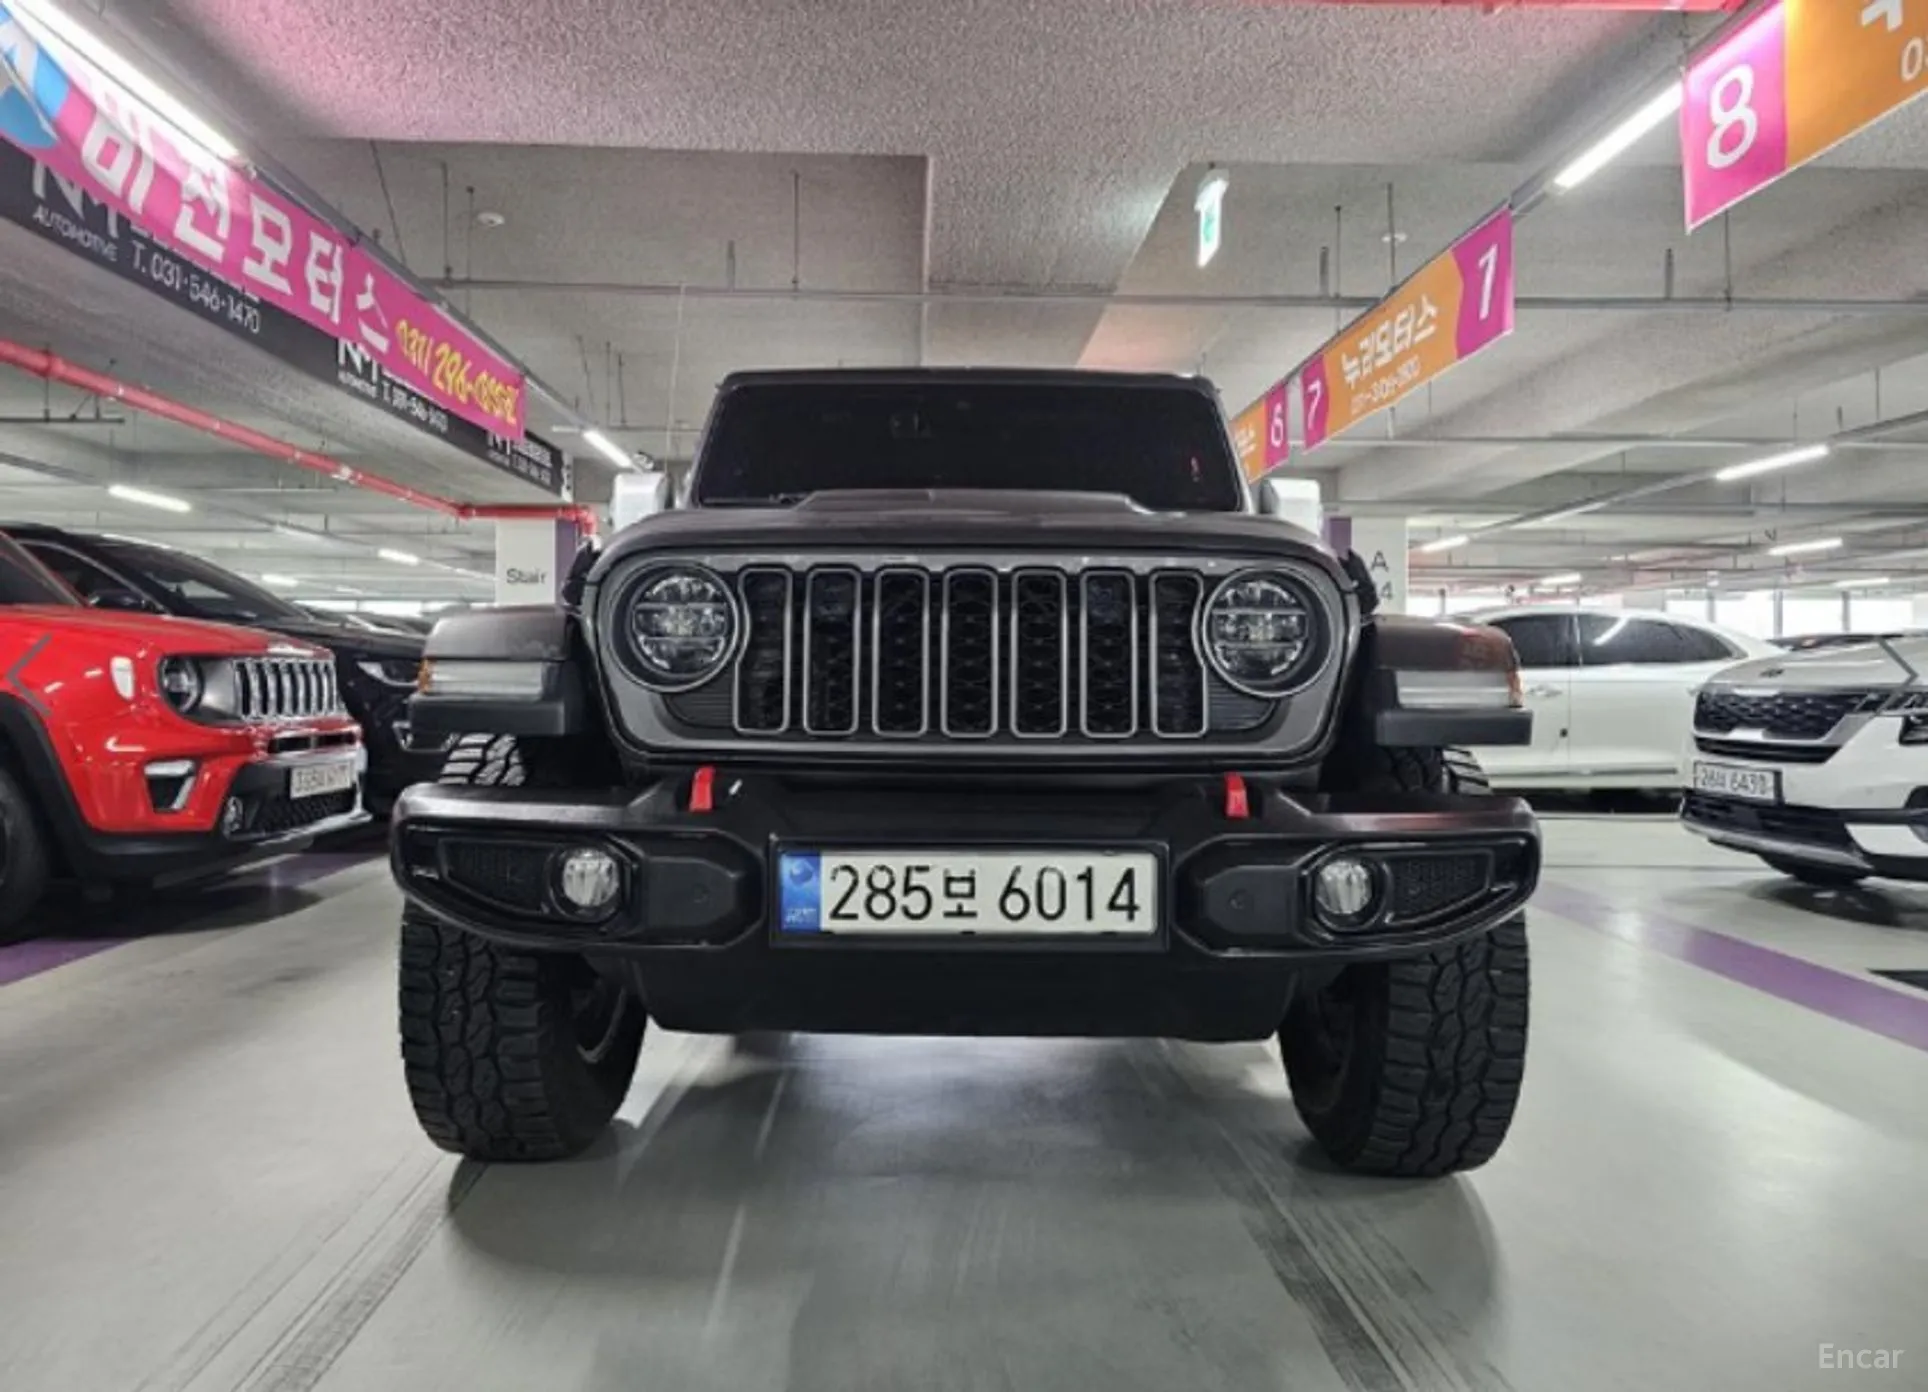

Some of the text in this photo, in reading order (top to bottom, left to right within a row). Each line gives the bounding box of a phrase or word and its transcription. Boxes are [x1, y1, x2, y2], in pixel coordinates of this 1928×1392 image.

[1706, 63, 1758, 170] 8
[32, 203, 118, 263] AUTOMOTIVE
[1270, 402, 1284, 449] 6
[1307, 379, 1322, 431] 7
[506, 568, 547, 585] Stair
[1371, 550, 1389, 573] A
[829, 864, 1140, 922] 285보 6014
